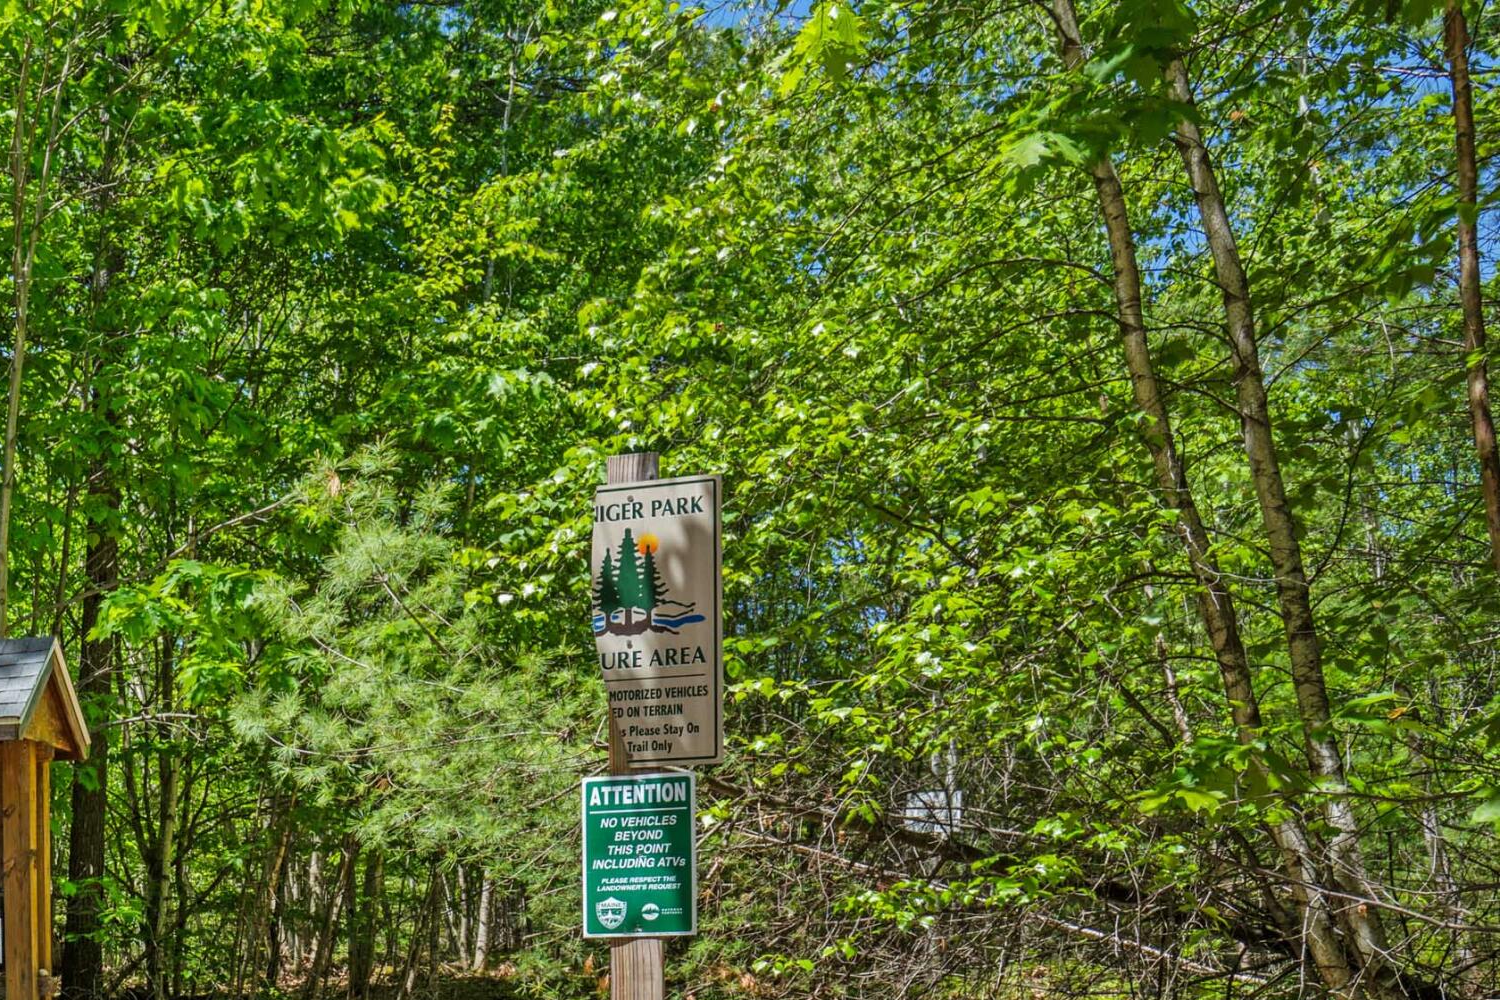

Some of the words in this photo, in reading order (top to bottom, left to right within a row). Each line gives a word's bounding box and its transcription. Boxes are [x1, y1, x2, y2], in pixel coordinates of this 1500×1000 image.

[651, 495, 704, 517] PARK
[649, 645, 706, 667] AREA
[609, 688, 662, 702] MOTORIZED
[665, 685, 708, 698] VEHICLES
[626, 706, 640, 718] ON
[643, 703, 683, 717] TERRAIN
[629, 725, 661, 737] Please
[663, 723, 684, 737] Stay
[687, 722, 700, 734] On
[627, 740, 649, 752] Trail
[651, 739, 673, 753] Only
[590, 782, 686, 806] ATTENTION
[600, 817, 618, 829] NO
[621, 815, 677, 827] VEHICLES
[614, 829, 663, 841] BEYOND
[608, 845, 634, 855] THIS
[636, 843, 672, 854] POINT
[592, 857, 655, 870] INCLUDING
[657, 856, 686, 868] ATVs
[596, 884, 647, 892] LANDOWNER'S
[648, 882, 682, 890] REQUEST
